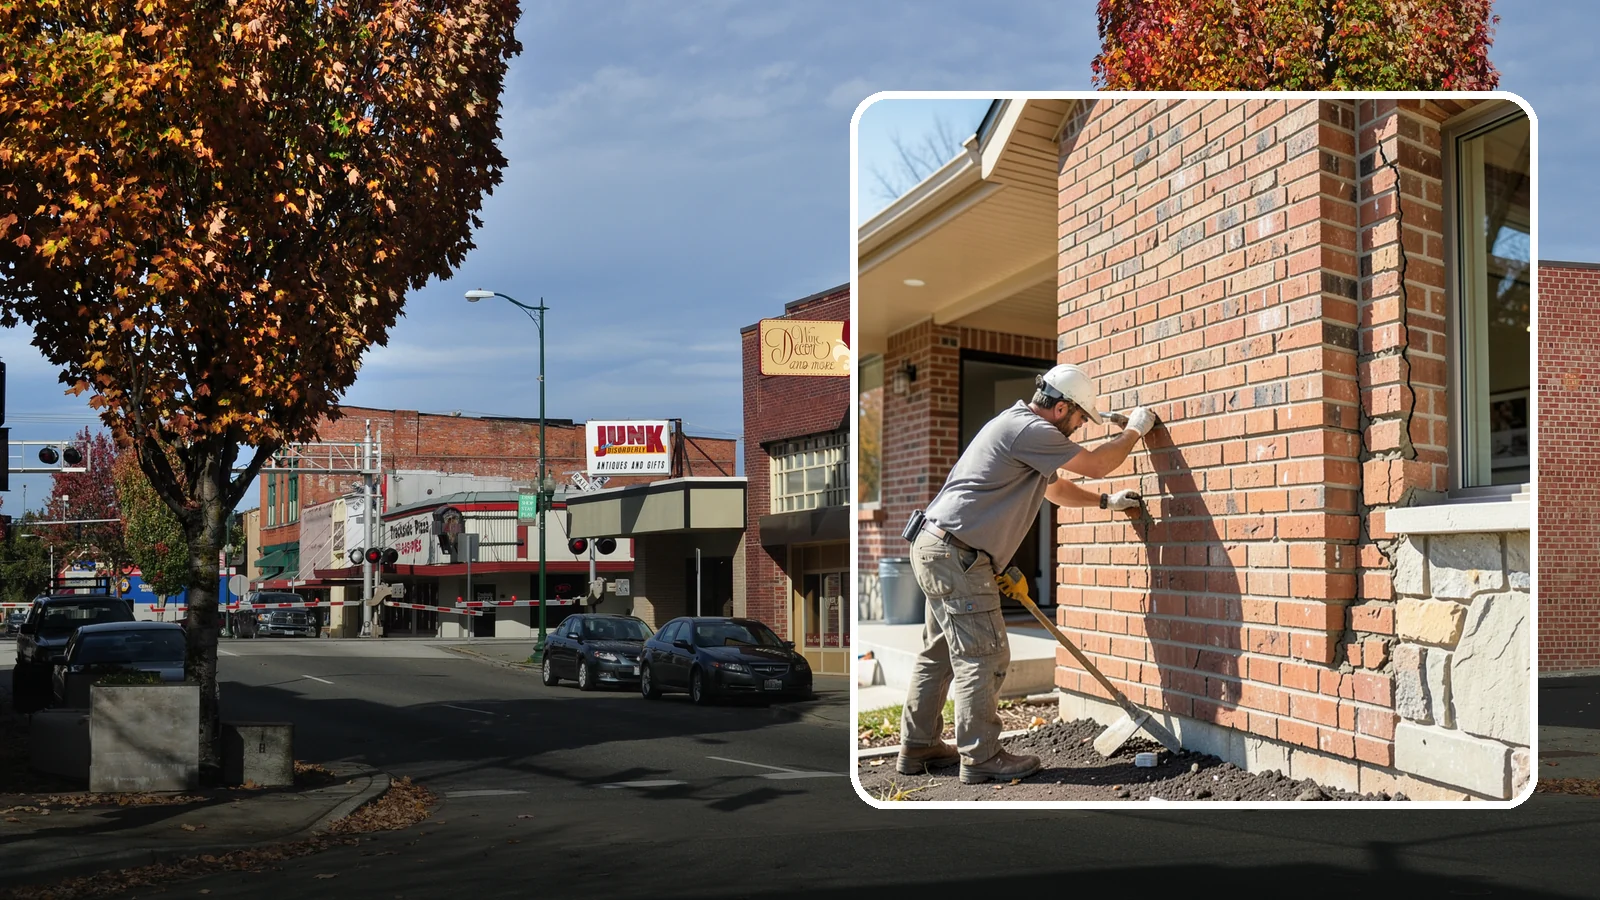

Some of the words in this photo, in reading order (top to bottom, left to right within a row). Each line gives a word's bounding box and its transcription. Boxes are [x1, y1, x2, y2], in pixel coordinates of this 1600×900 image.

[595, 425, 665, 457] JUNK
[607, 446, 646, 454] DISORDERLY
[596, 461, 628, 470] ANTIQUES
[631, 460, 644, 470] AND
[647, 460, 665, 469] GIFTS
[414, 520, 430, 536] Pizza
